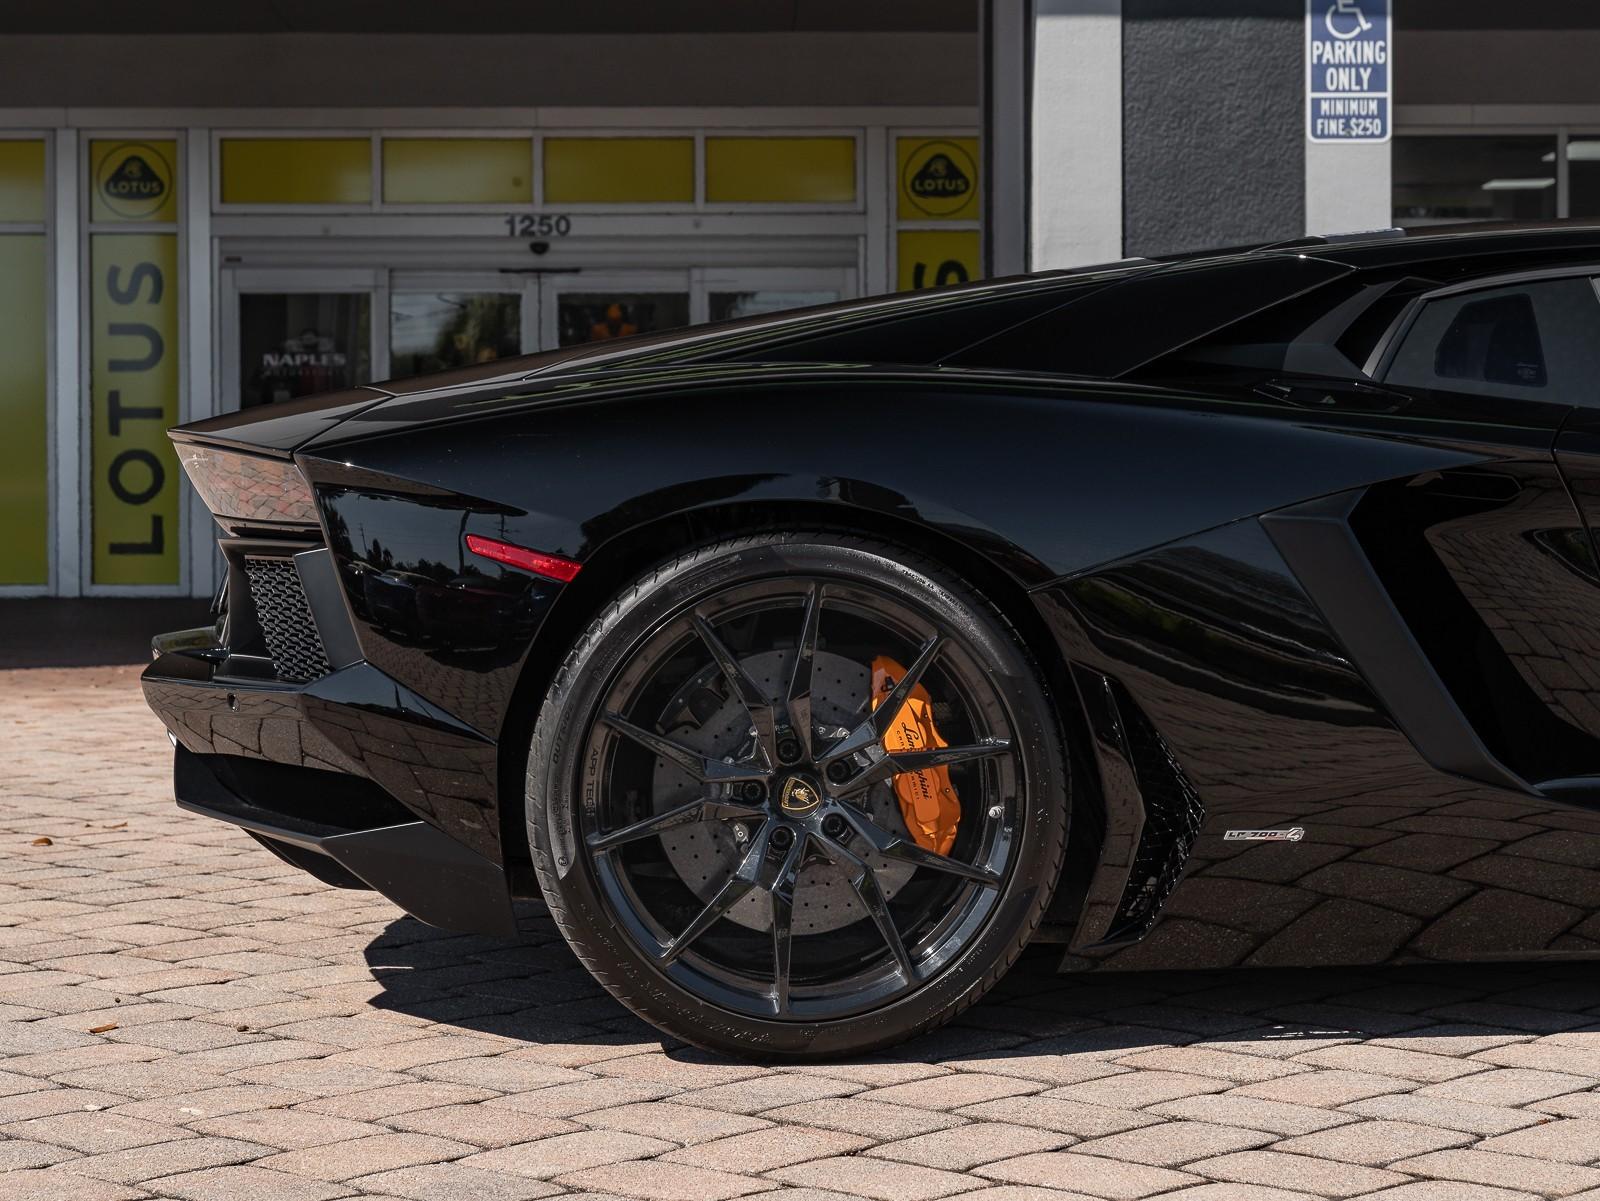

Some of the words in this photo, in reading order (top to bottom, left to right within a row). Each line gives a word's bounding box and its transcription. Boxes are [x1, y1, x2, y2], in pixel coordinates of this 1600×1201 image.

[1312, 41, 1386, 65] PARKING
[1325, 67, 1371, 91] ONLY
[1320, 99, 1378, 116] MINIMUM
[1316, 118, 1345, 135] FINE
[1350, 117, 1382, 137] $250
[109, 181, 162, 194] LOTUS
[914, 178, 966, 191] LOTUS
[504, 214, 571, 236] 1250
[262, 353, 347, 366] NAPLES
[107, 262, 165, 555] LOTUS
